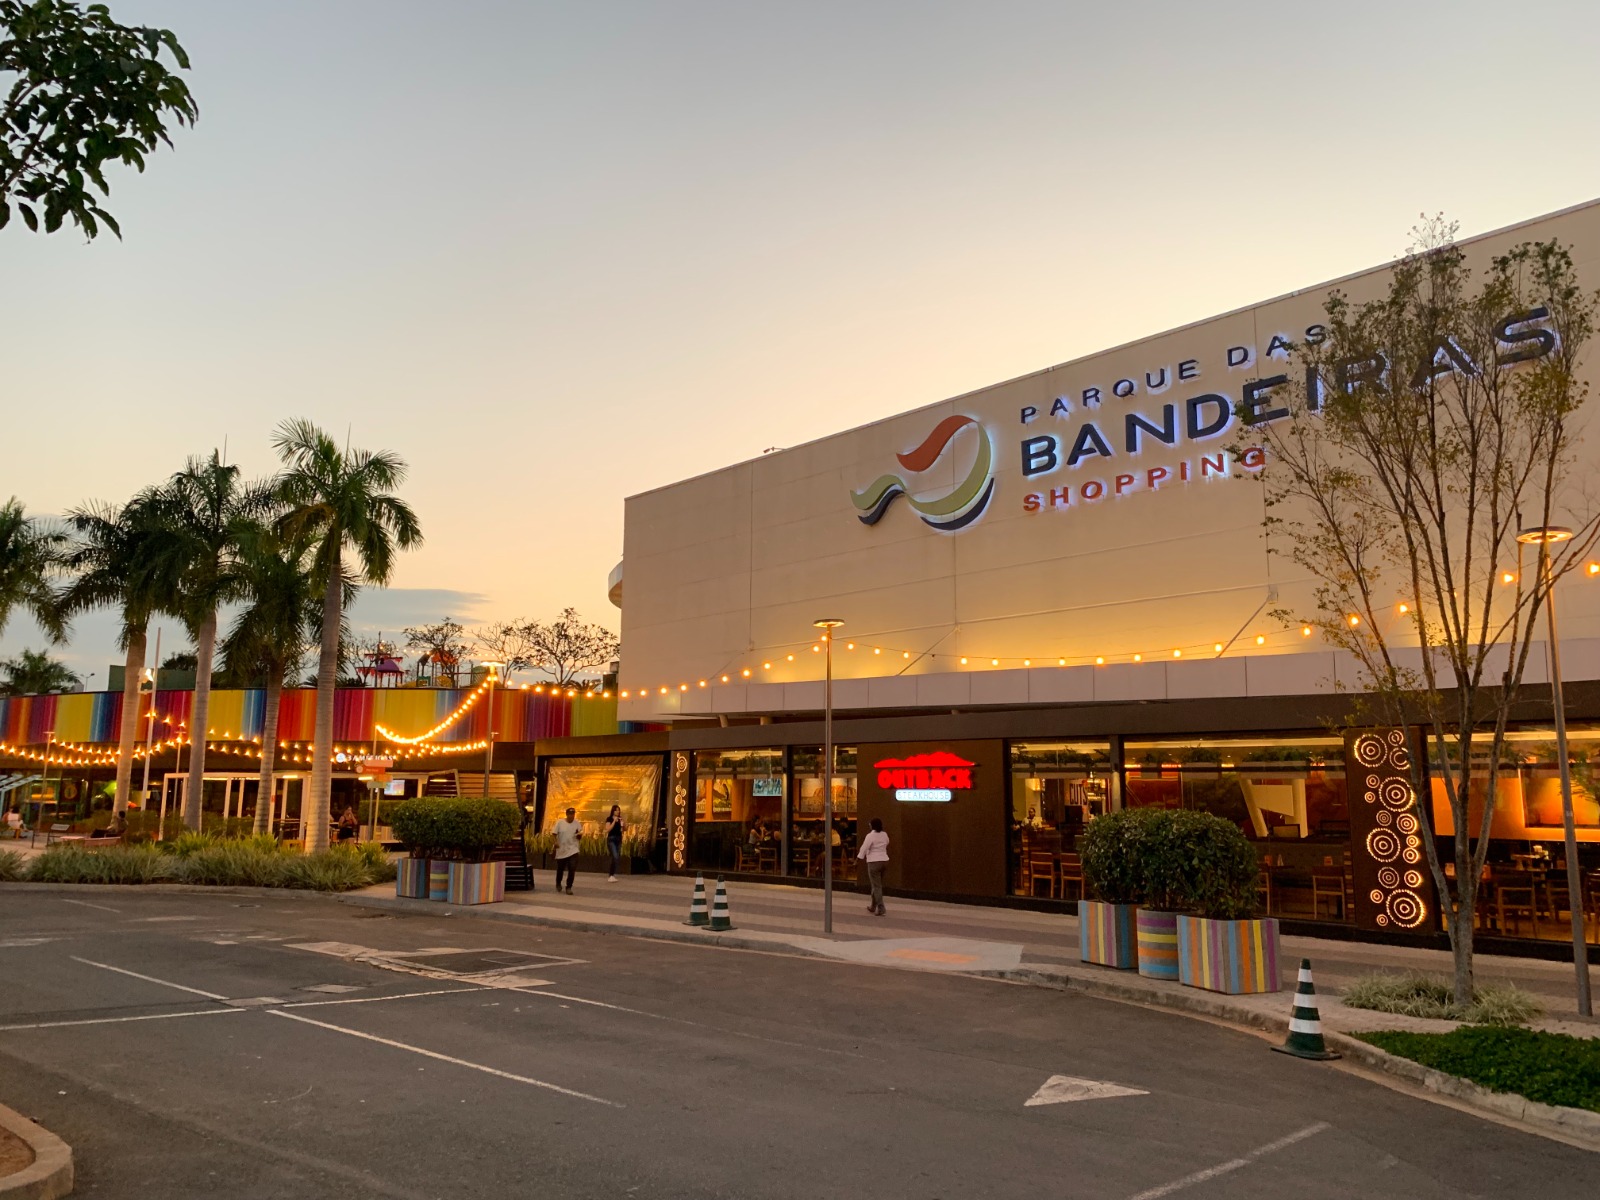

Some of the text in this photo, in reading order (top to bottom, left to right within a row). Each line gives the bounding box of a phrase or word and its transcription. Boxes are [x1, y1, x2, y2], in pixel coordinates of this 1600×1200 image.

[1021, 325, 1327, 424] PARQUE DAS
[1021, 306, 1555, 477] BANDEIRAS
[1023, 447, 1266, 512] SHOPPING
[877, 769, 972, 789] OUTBACK
[897, 791, 950, 800] STEAKHOUSE
